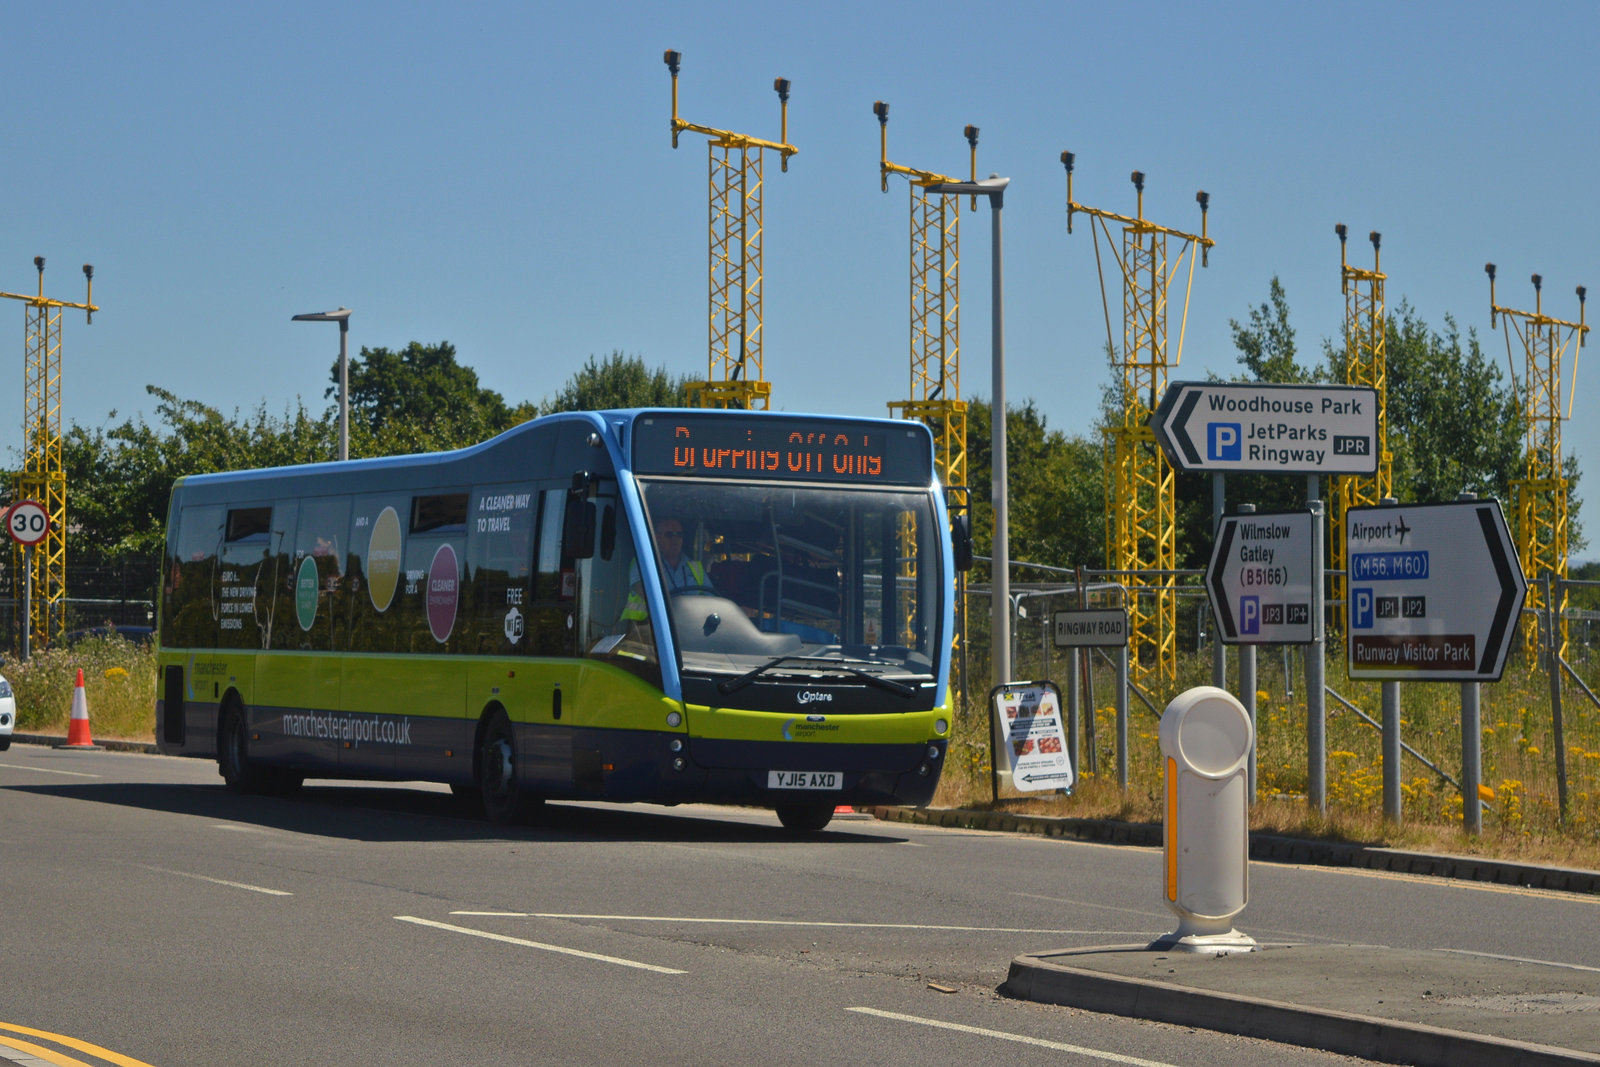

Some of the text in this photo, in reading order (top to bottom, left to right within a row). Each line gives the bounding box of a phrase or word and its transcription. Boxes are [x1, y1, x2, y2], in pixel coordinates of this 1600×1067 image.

[1208, 394, 1362, 415] Woodhouse Park
[1247, 423, 1328, 441] JetParks
[1215, 427, 1237, 458] P
[1336, 439, 1365, 453] JPR
[1248, 444, 1326, 465] Ringway
[479, 494, 531, 511] A CLEANER WAY
[13, 513, 45, 532] 30
[477, 517, 510, 533] TO TRAVEL
[1240, 523, 1290, 540] Wilmslow
[1351, 522, 1392, 542] Airport
[1240, 546, 1274, 564] Gatley
[406, 569, 424, 580] DRIVING
[405, 584, 414, 595] FOR
[431, 578, 455, 592] CLEANER
[506, 588, 523, 605] FREE
[1244, 599, 1308, 632] P JP3 JP+
[1356, 592, 1423, 625] P JP1 JP2
[1058, 621, 1122, 636] RINGWAY ROAD
[1356, 642, 1471, 665] Runway Visitor Park
[802, 690, 833, 703] Optare
[283, 710, 412, 749] manchesterairport.co.uk
[796, 722, 840, 731] manchester
[777, 773, 836, 787] YJ15 AXD
